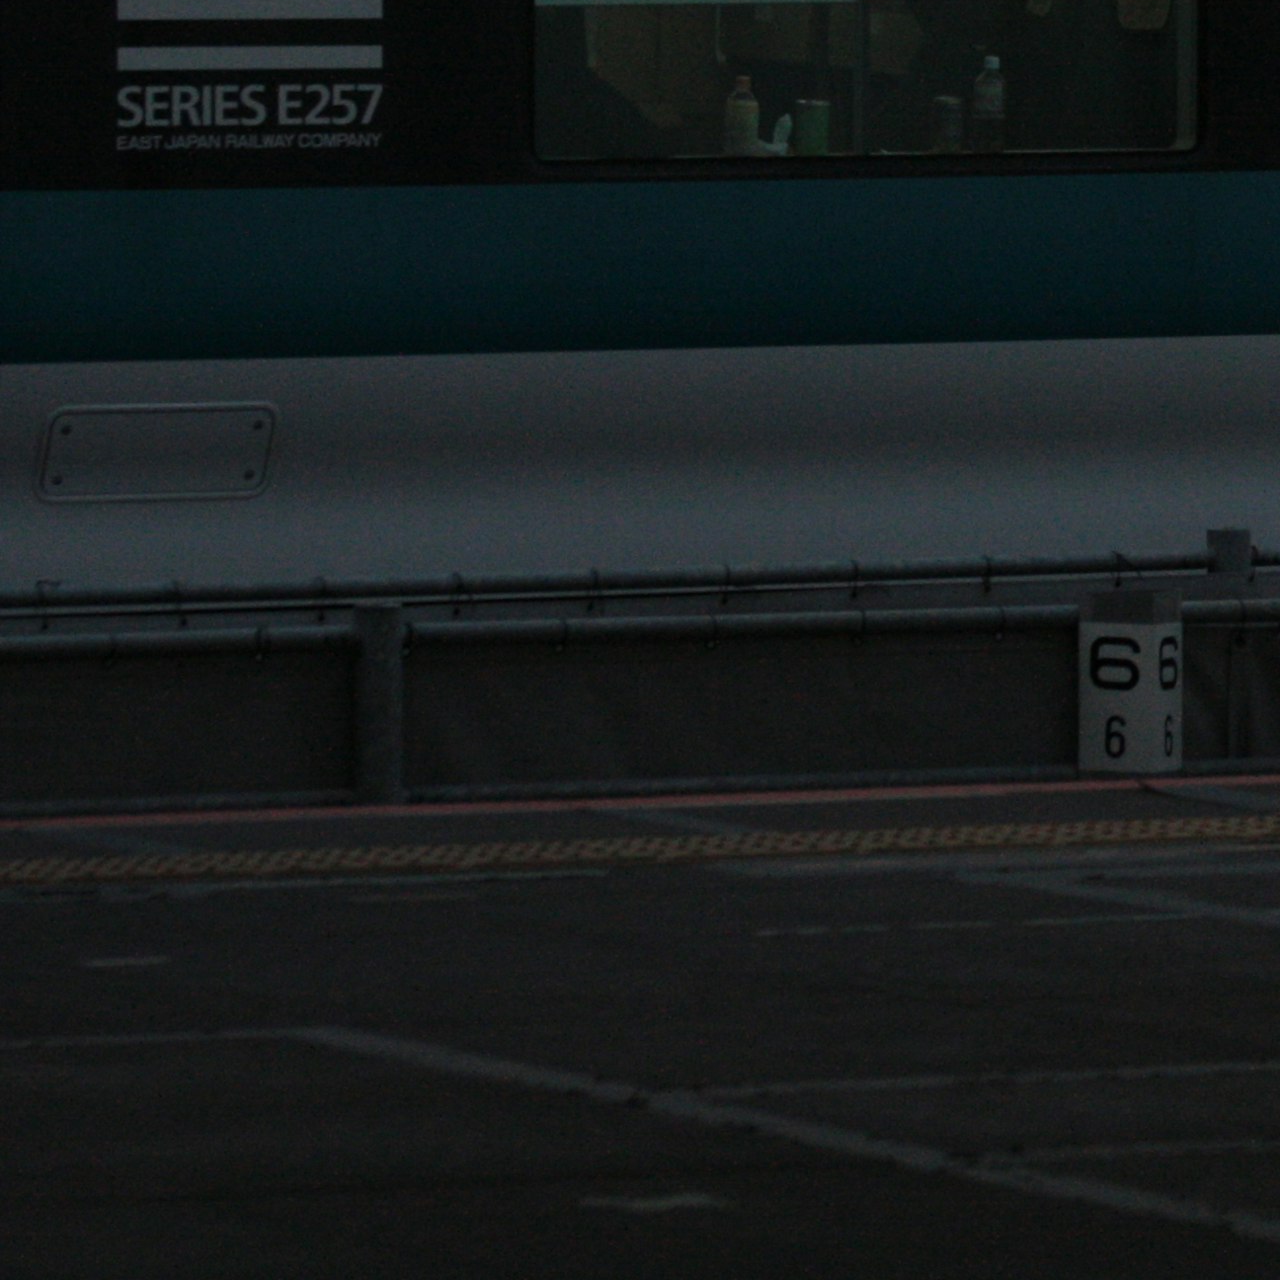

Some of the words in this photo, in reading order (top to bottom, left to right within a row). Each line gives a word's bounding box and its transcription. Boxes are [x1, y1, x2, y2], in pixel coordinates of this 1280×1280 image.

[117, 85, 268, 128] SERIES
[278, 83, 384, 125] E257
[116, 136, 162, 152] EAST
[164, 135, 222, 151] JAPAN
[225, 133, 295, 150] RAILWAY
[298, 132, 383, 148] COMPANY
[1090, 637, 1140, 689] 6
[1159, 637, 1177, 690] 6
[1106, 716, 1125, 758] 6
